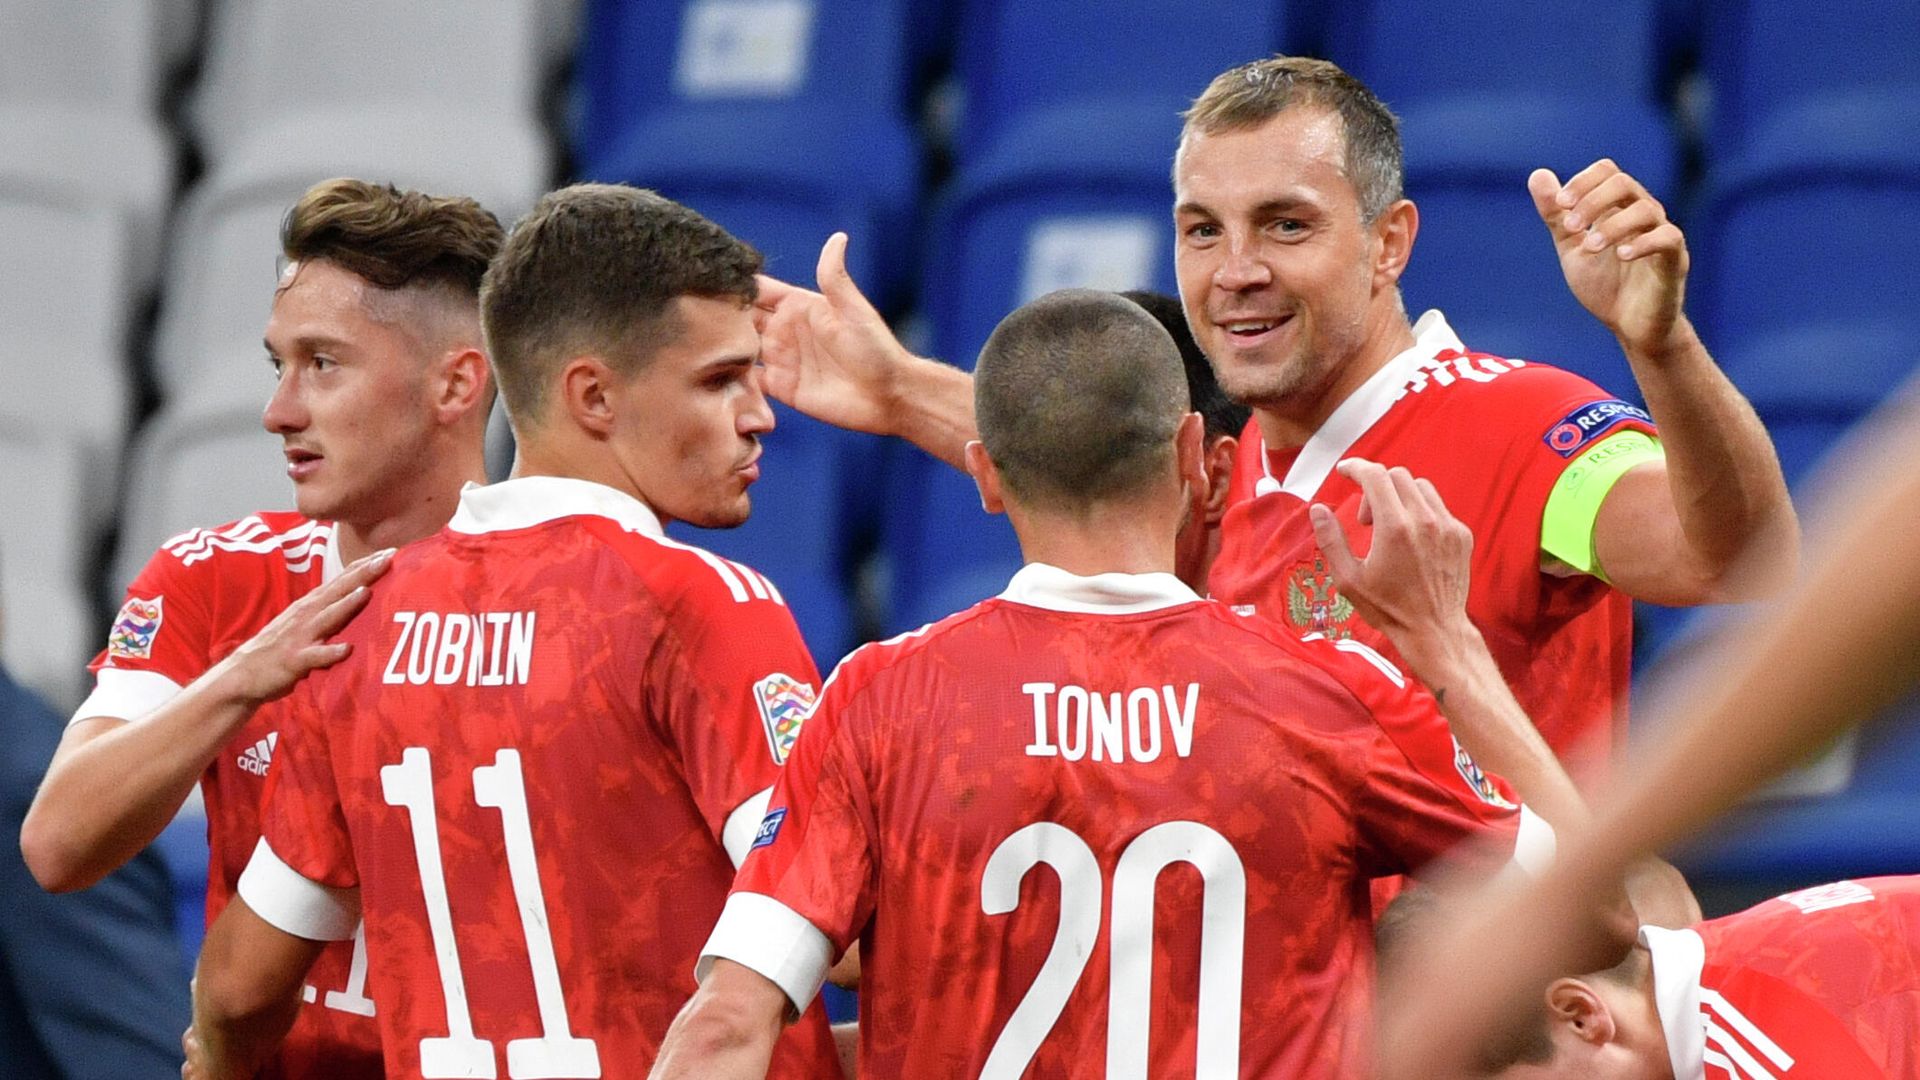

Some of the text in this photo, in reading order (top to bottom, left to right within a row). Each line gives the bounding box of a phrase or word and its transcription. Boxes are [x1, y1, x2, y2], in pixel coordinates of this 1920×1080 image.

[382, 610, 537, 687] ZOBNIN
[1022, 682, 1200, 764] IONOV
[380, 747, 602, 1080] 11
[979, 820, 1247, 1080] 20
